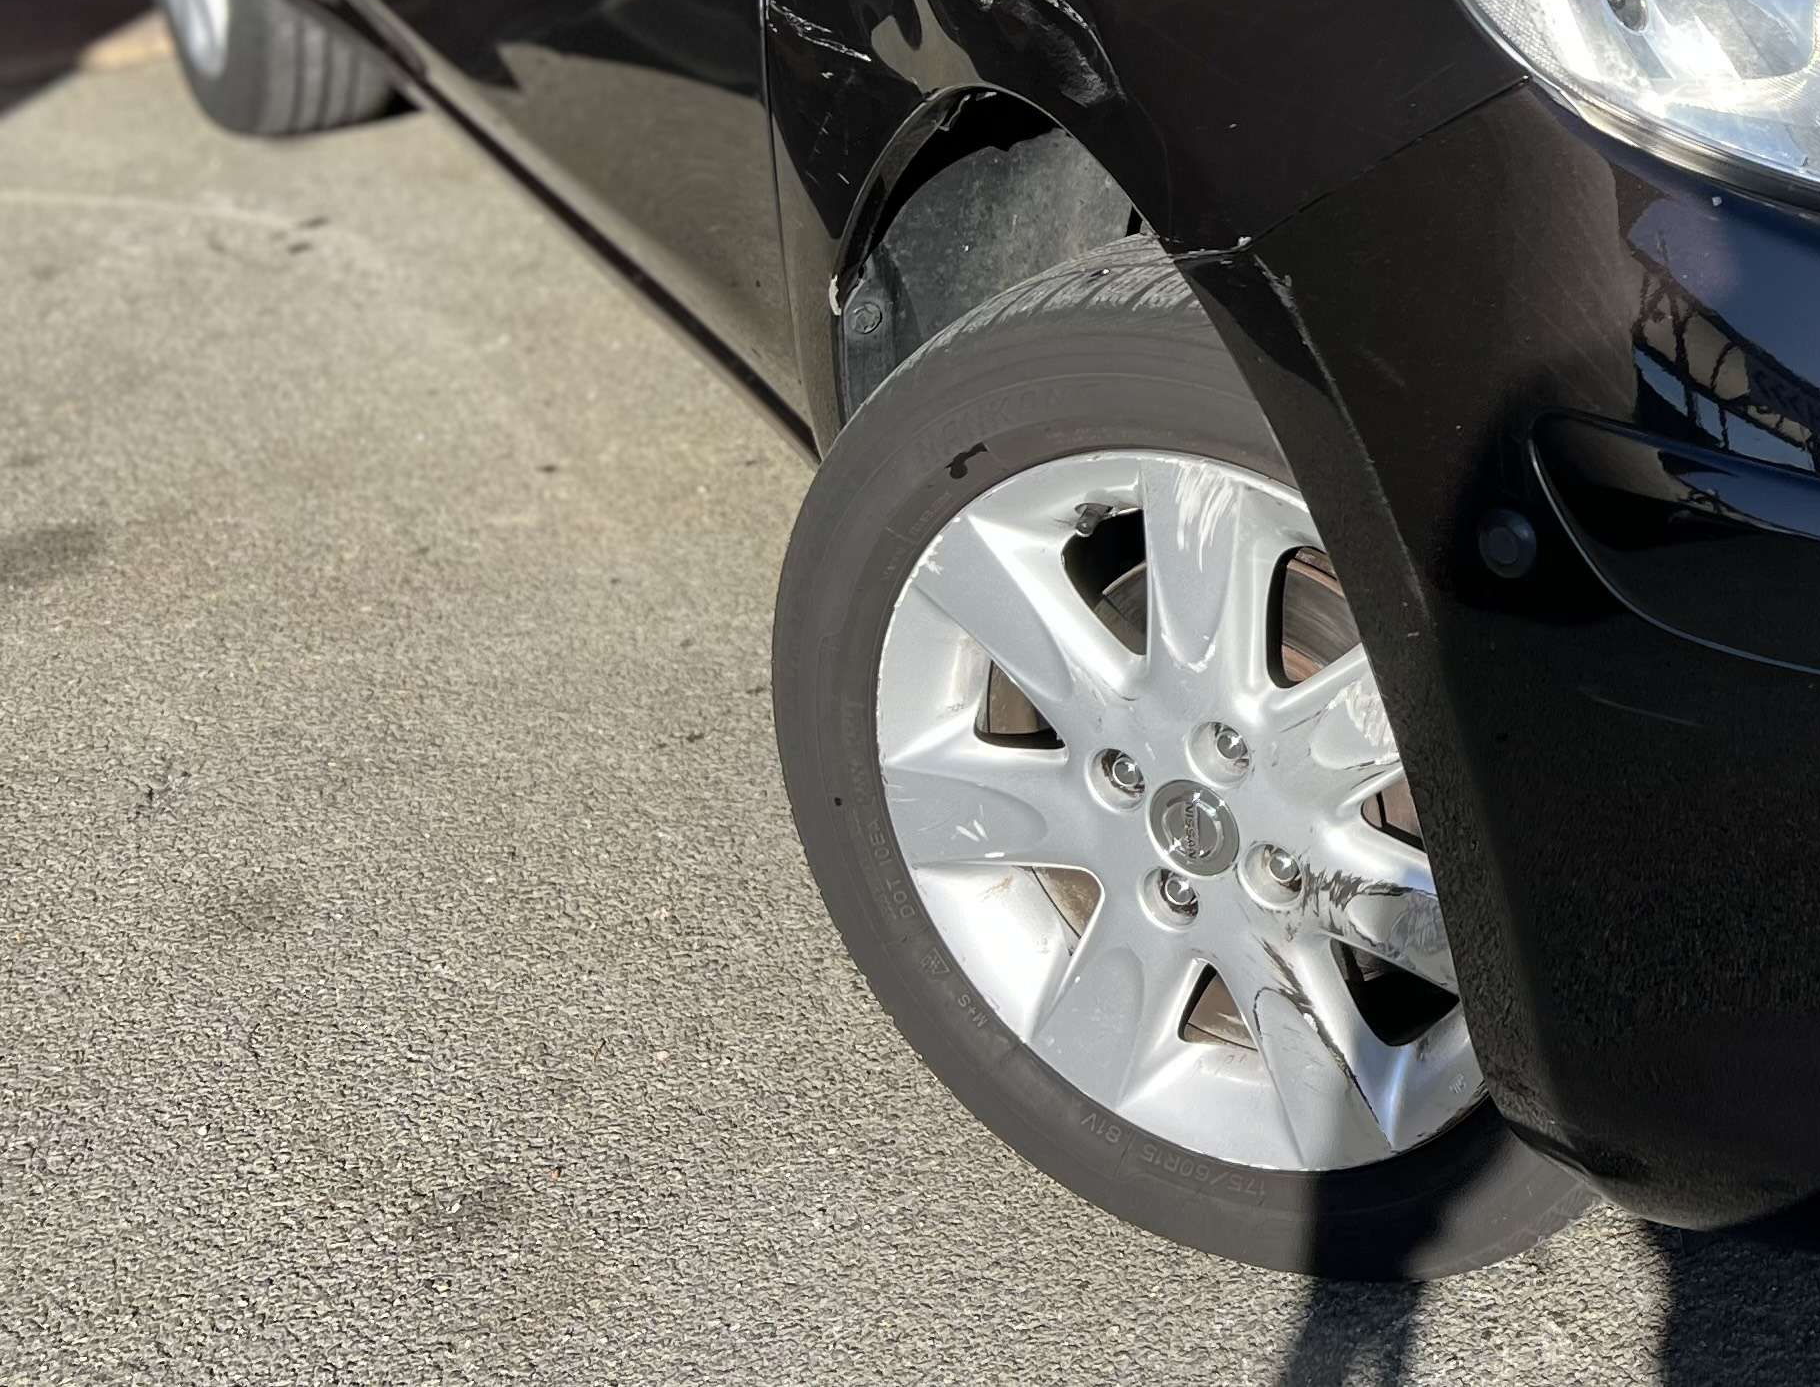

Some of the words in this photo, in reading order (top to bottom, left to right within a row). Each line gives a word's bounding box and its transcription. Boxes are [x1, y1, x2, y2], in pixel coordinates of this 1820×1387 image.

[1184, 801, 1198, 860] NISSAN
[886, 876, 916, 919] DOT
[957, 994, 989, 1028] M+S
[1081, 1112, 1123, 1143] 81V
[1141, 1143, 1266, 1196] 175/60R15
